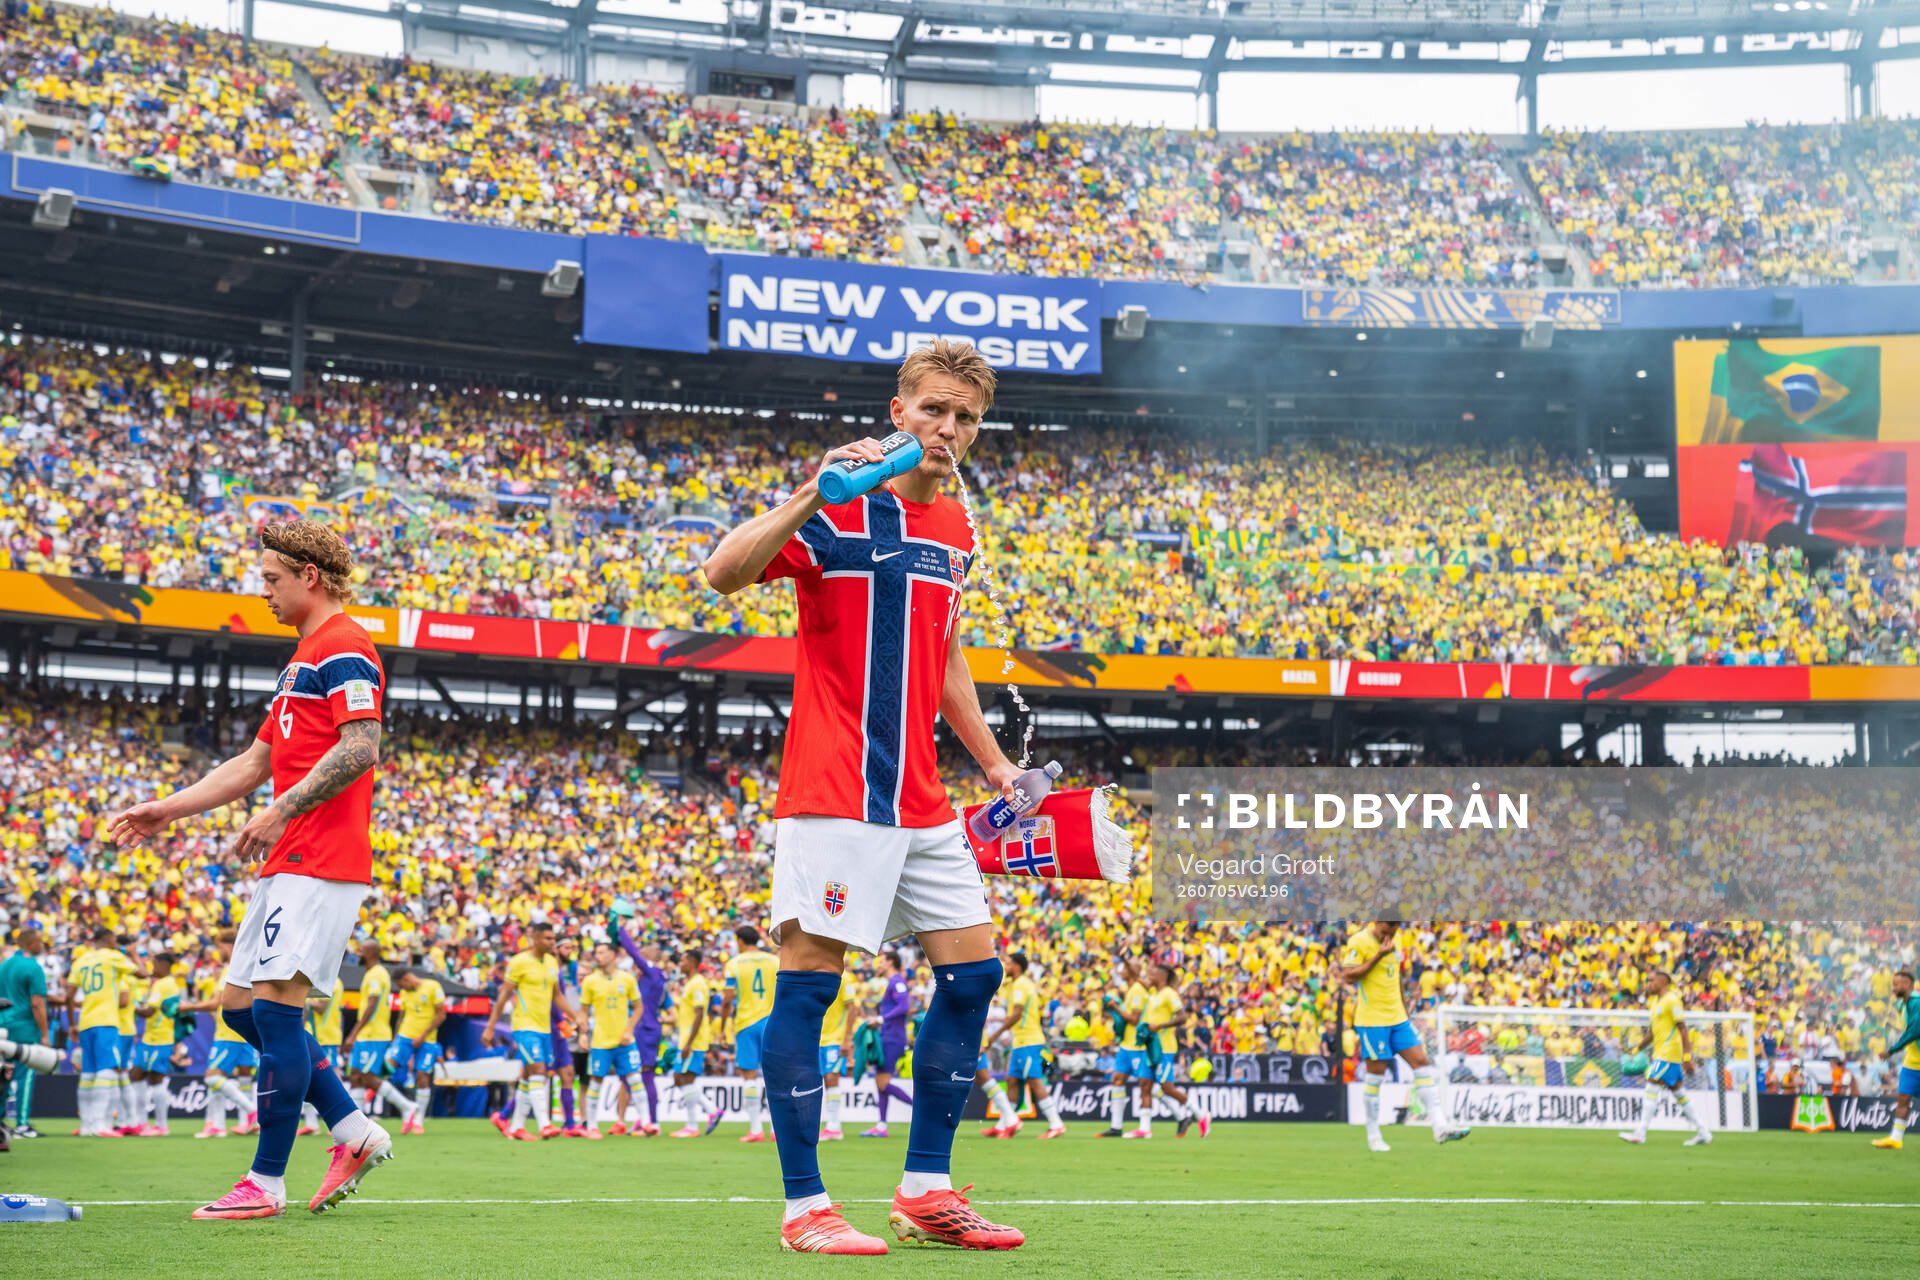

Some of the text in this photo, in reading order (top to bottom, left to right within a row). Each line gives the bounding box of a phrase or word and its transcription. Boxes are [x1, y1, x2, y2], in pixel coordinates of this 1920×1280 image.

[728, 273, 1090, 333] NEW YORK
[727, 319, 858, 356] NEW
[279, 696, 294, 740] 6
[993, 788, 1031, 823] smart
[264, 905, 283, 948] 6
[79, 962, 104, 995] 26
[752, 968, 766, 999] 4
[841, 1090, 880, 1109] IFA
[1253, 1092, 1301, 1113] FIFA
[1535, 1094, 1643, 1124] EDUCATION
[1840, 1097, 1891, 1133] Unite
